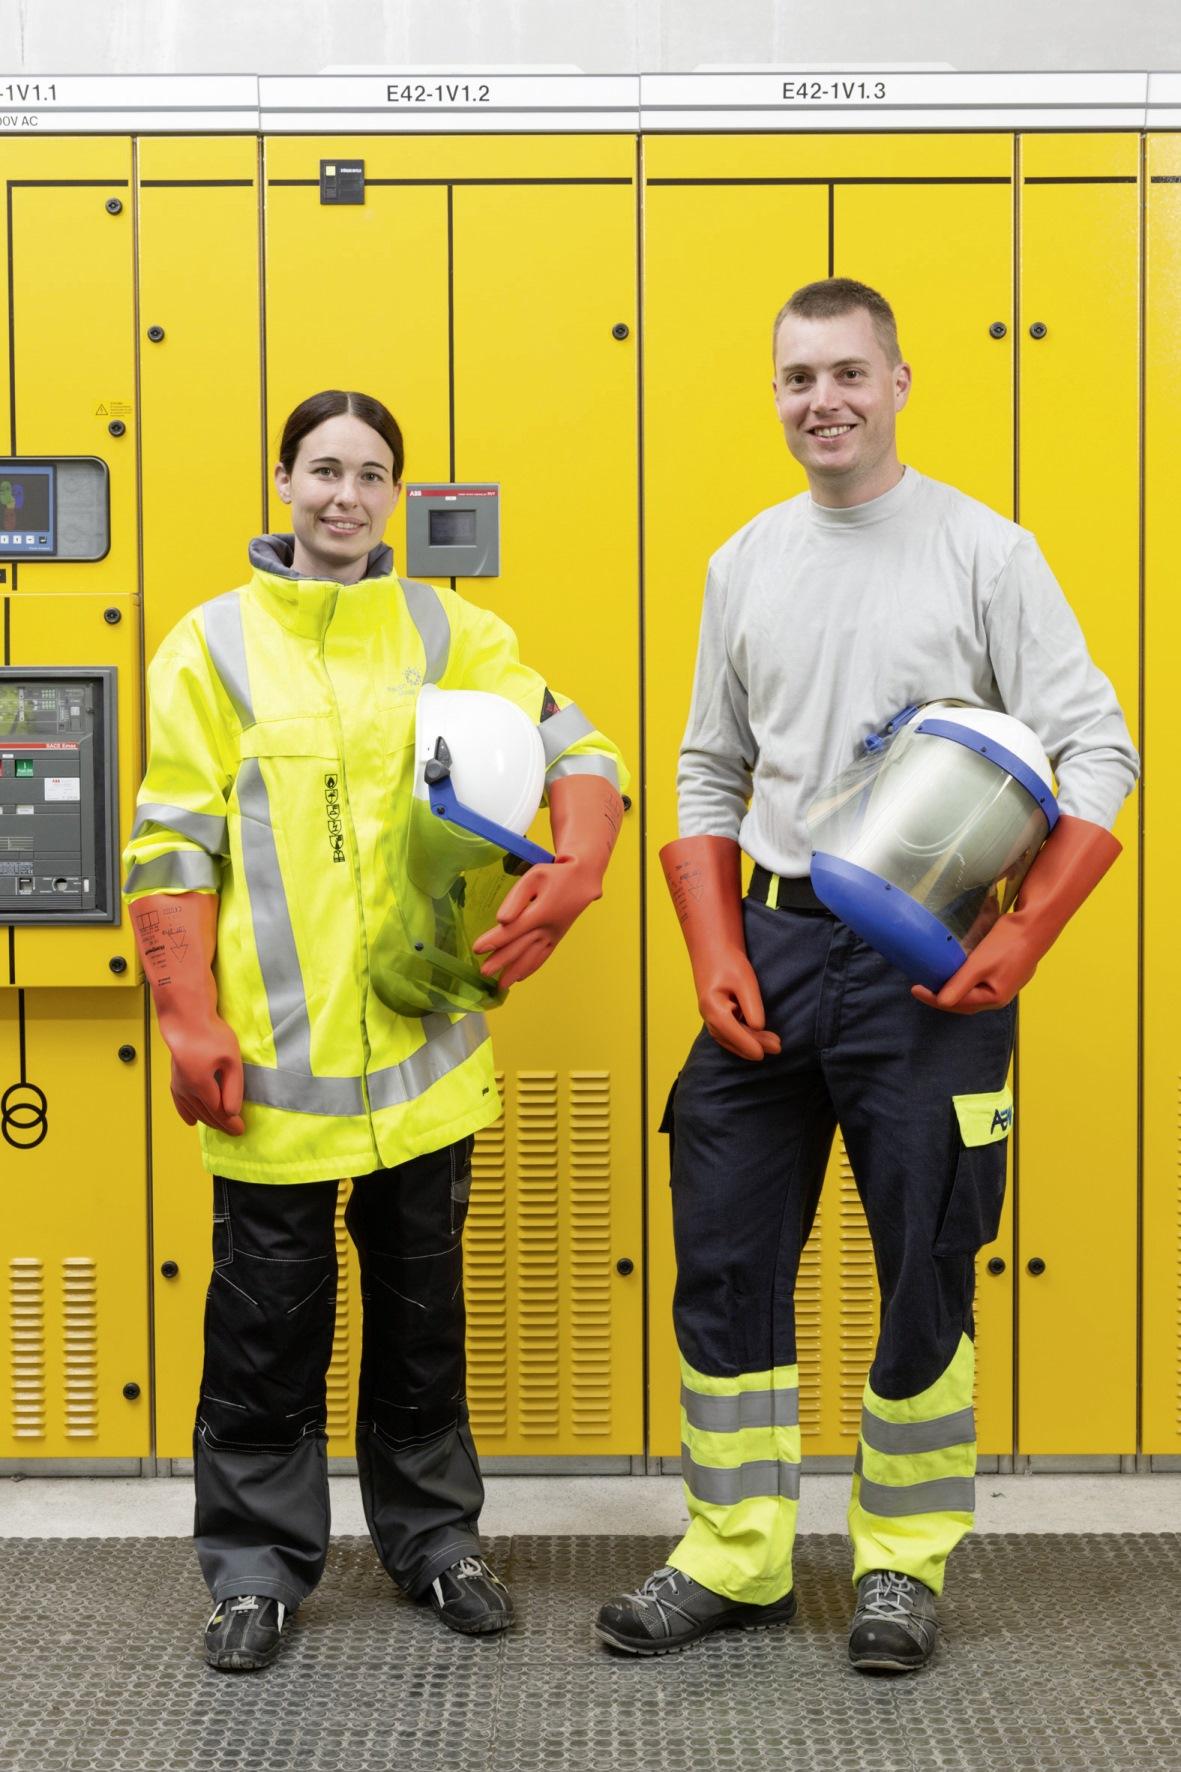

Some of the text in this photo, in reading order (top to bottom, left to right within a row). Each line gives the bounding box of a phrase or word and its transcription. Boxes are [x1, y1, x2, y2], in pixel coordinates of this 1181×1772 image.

[387, 84, 490, 102] E42-1V1.2
[783, 82, 886, 99] E42-1V1.3
[0, 115, 38, 127] 0V AC
